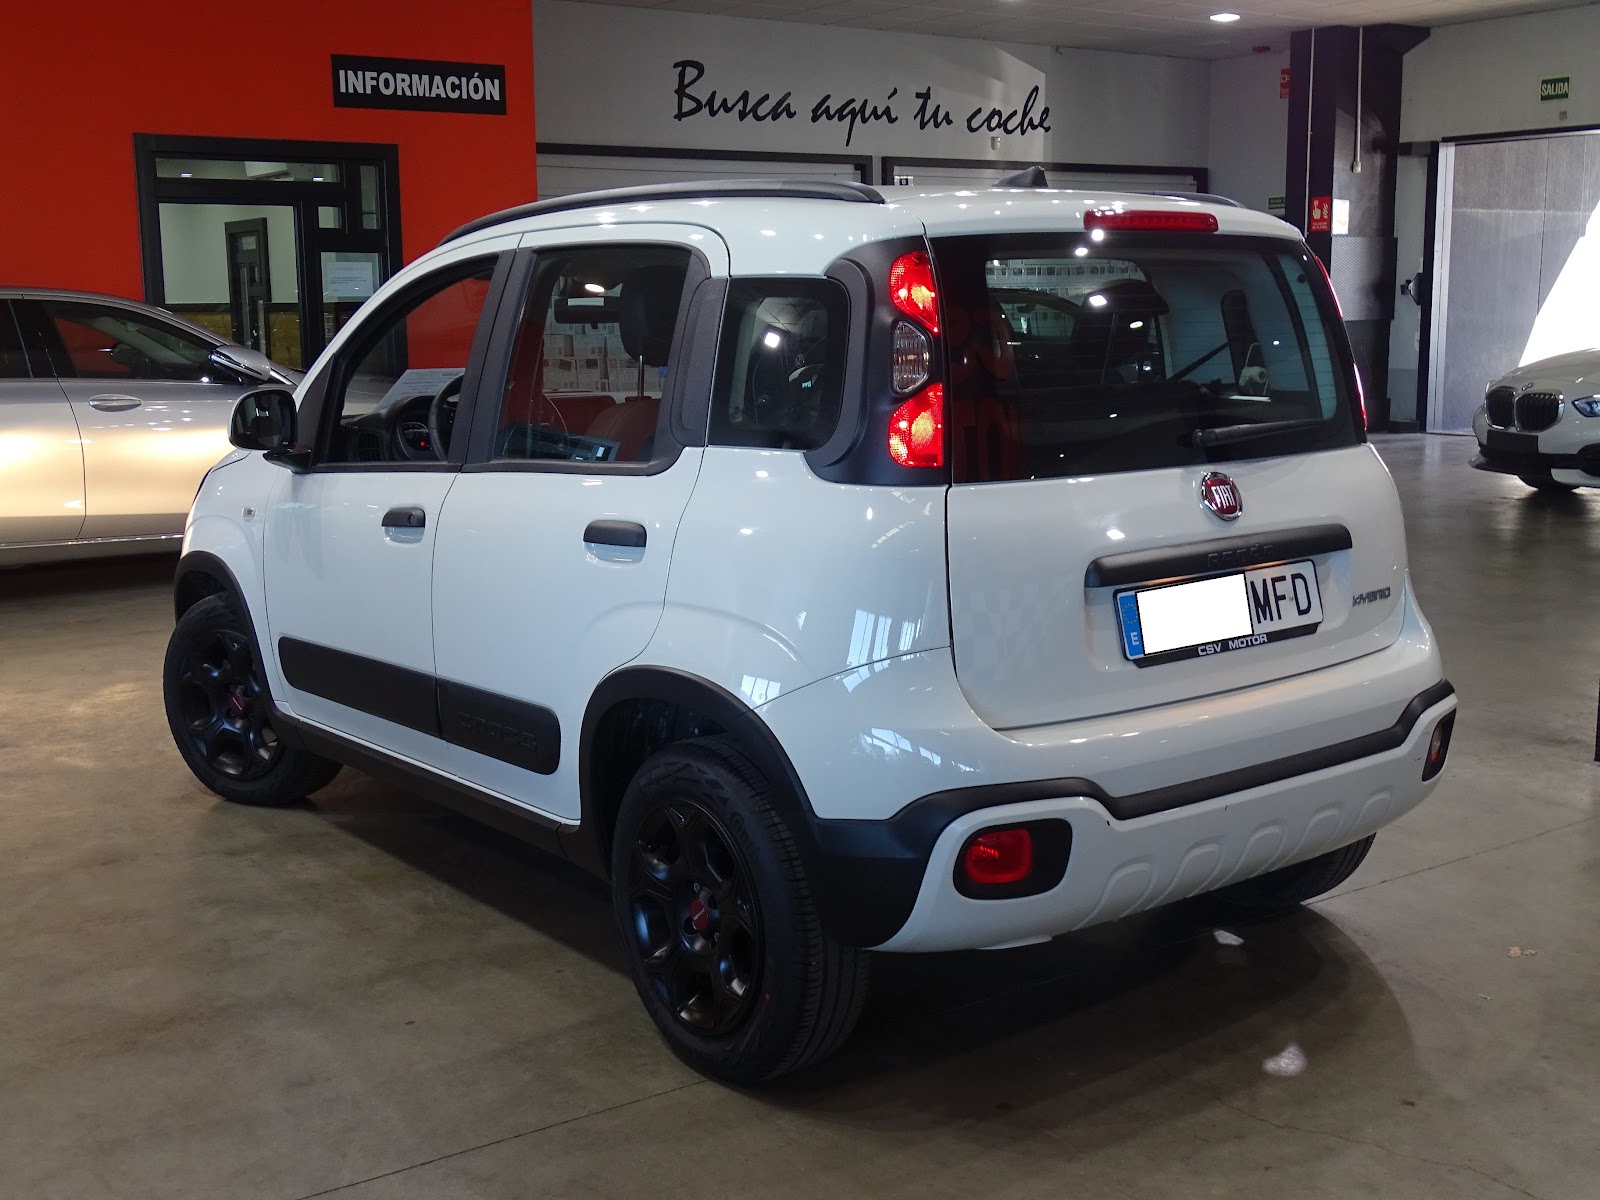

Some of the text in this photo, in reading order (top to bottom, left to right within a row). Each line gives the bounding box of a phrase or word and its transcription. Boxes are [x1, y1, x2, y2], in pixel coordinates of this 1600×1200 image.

[339, 69, 500, 100] INFORMACIÓN
[1541, 82, 1569, 97] SALIDA
[673, 59, 1052, 147] Busca aquí tu coche
[1211, 484, 1236, 509] FIAT
[1250, 572, 1312, 624] MFD
[1130, 631, 1140, 646] E
[1198, 633, 1268, 656] CSV MOTOR
